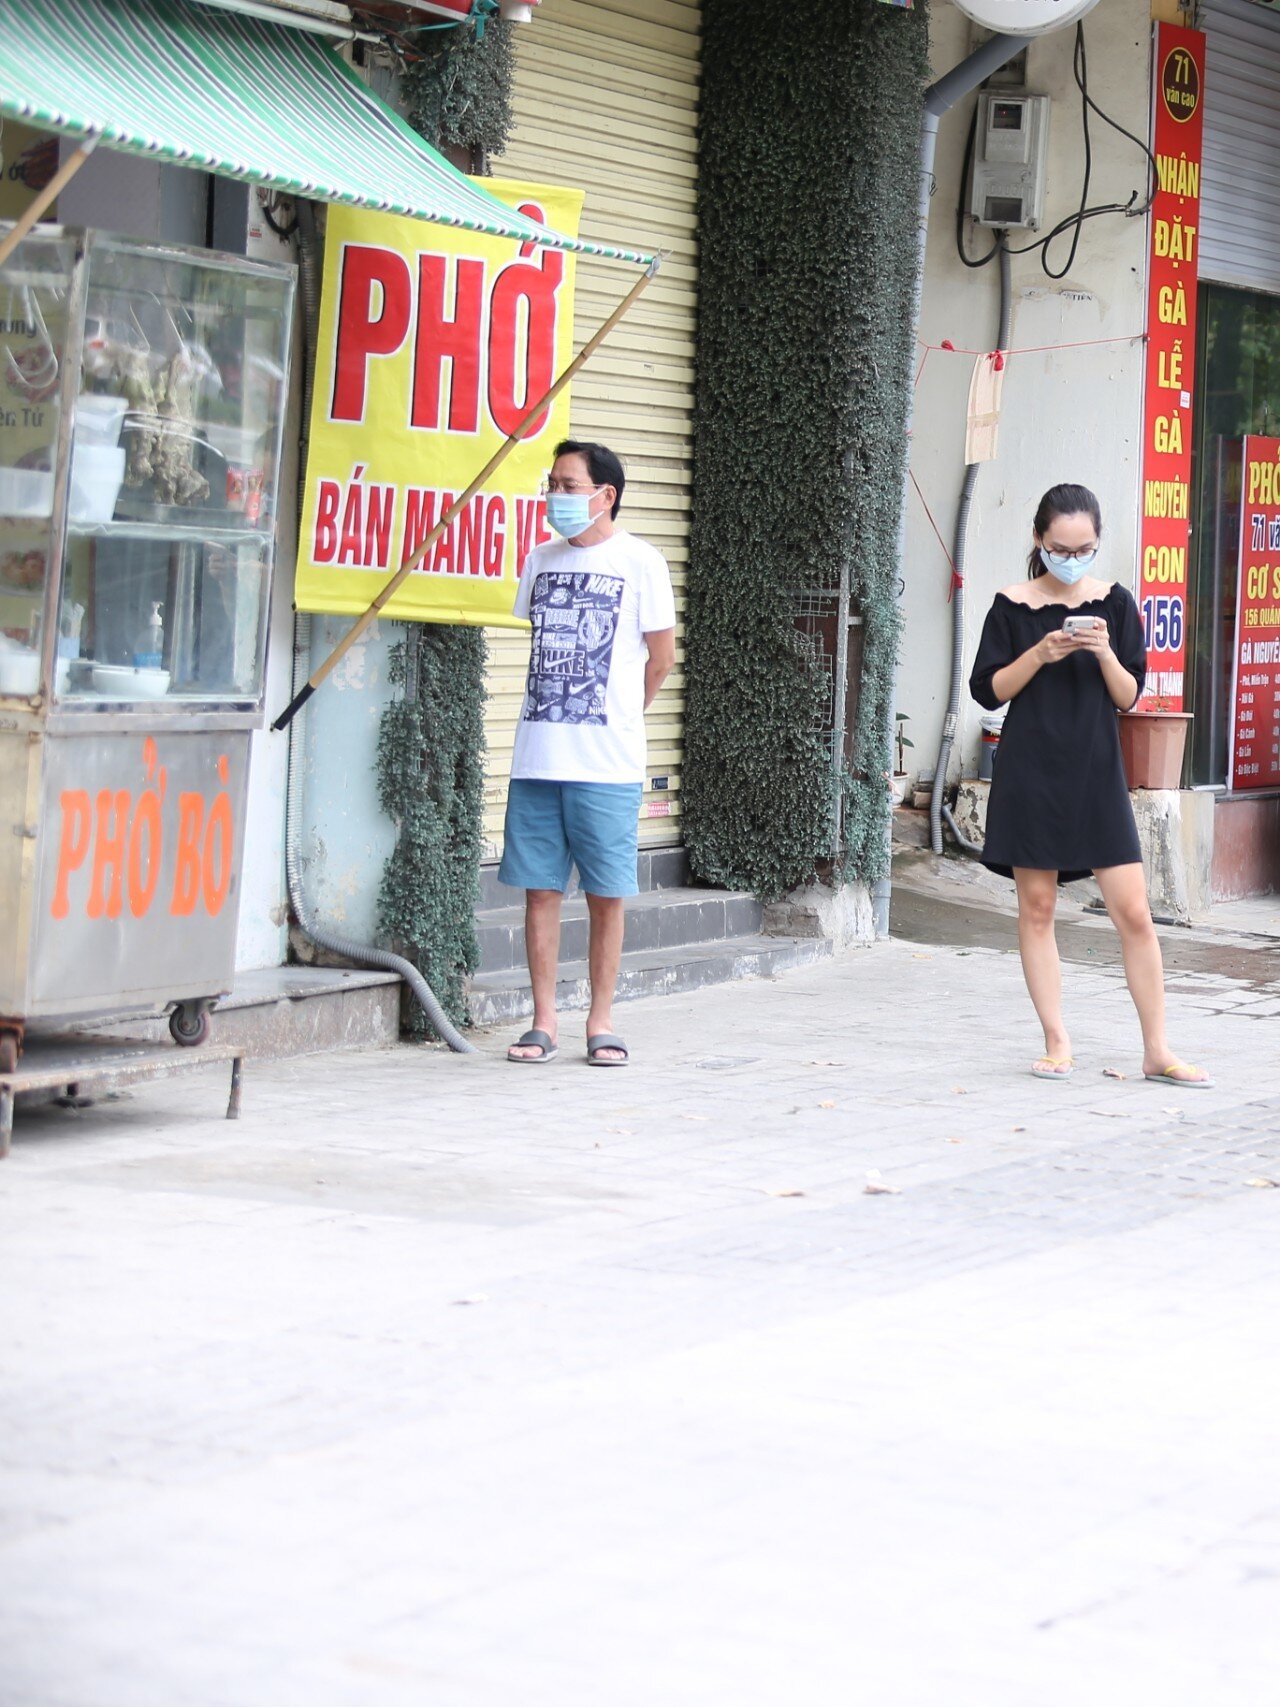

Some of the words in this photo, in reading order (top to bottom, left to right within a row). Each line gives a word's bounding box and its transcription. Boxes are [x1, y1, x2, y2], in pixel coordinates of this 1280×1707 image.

[1174, 54, 1189, 85] 71
[1156, 152, 1199, 204] NHẬN
[1155, 215, 1196, 268] ĐẶT
[329, 201, 565, 438] PHỞ
[1158, 281, 1187, 326] GÀ
[1158, 339, 1183, 390] LỄ
[1154, 409, 1183, 455] GÀ
[1144, 474, 1188, 519] NGUYÊN
[313, 465, 395, 568] BÁN
[402, 489, 506, 578] MANG
[1251, 513, 1266, 552] 71
[584, 573, 624, 598] NIKE
[1143, 546, 1185, 584] CON
[1247, 562, 1270, 600] CƠ
[1141, 595, 1183, 652] 156
[1244, 607, 1259, 626] 156
[1260, 604, 1280, 627] QUÁN
[540, 648, 586, 677] NIKE
[1241, 637, 1252, 665] GÀ
[50, 736, 168, 921] PHỞ
[169, 754, 234, 919] BÒ
